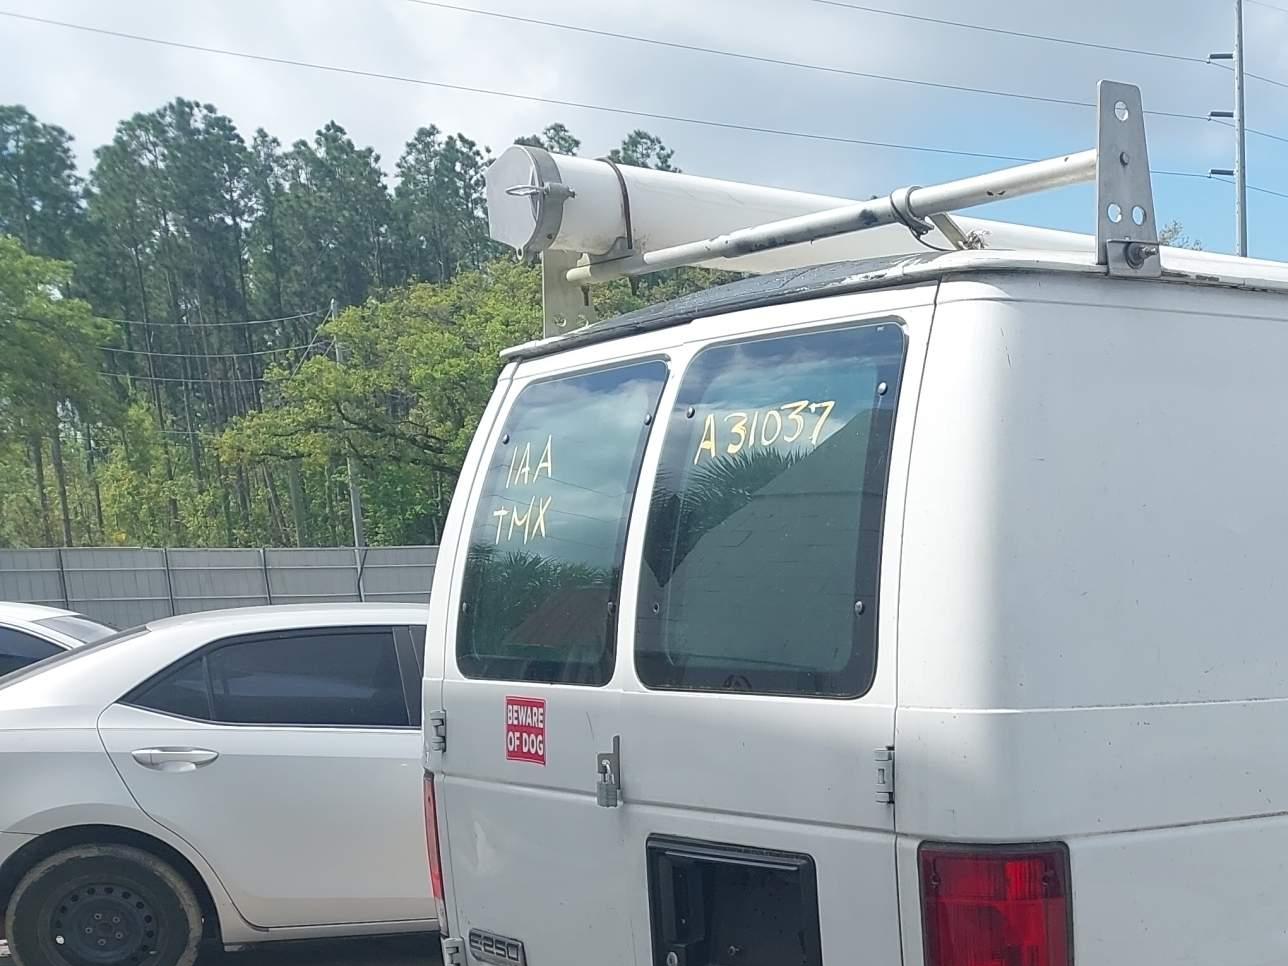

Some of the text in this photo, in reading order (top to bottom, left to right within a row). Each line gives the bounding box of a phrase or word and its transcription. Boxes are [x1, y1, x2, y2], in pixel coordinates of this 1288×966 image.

[694, 400, 835, 465] A31037
[506, 434, 552, 489] IAA
[493, 495, 552, 545] TMX
[507, 704, 544, 728] BEWARE
[507, 731, 544, 756] OF DOG
